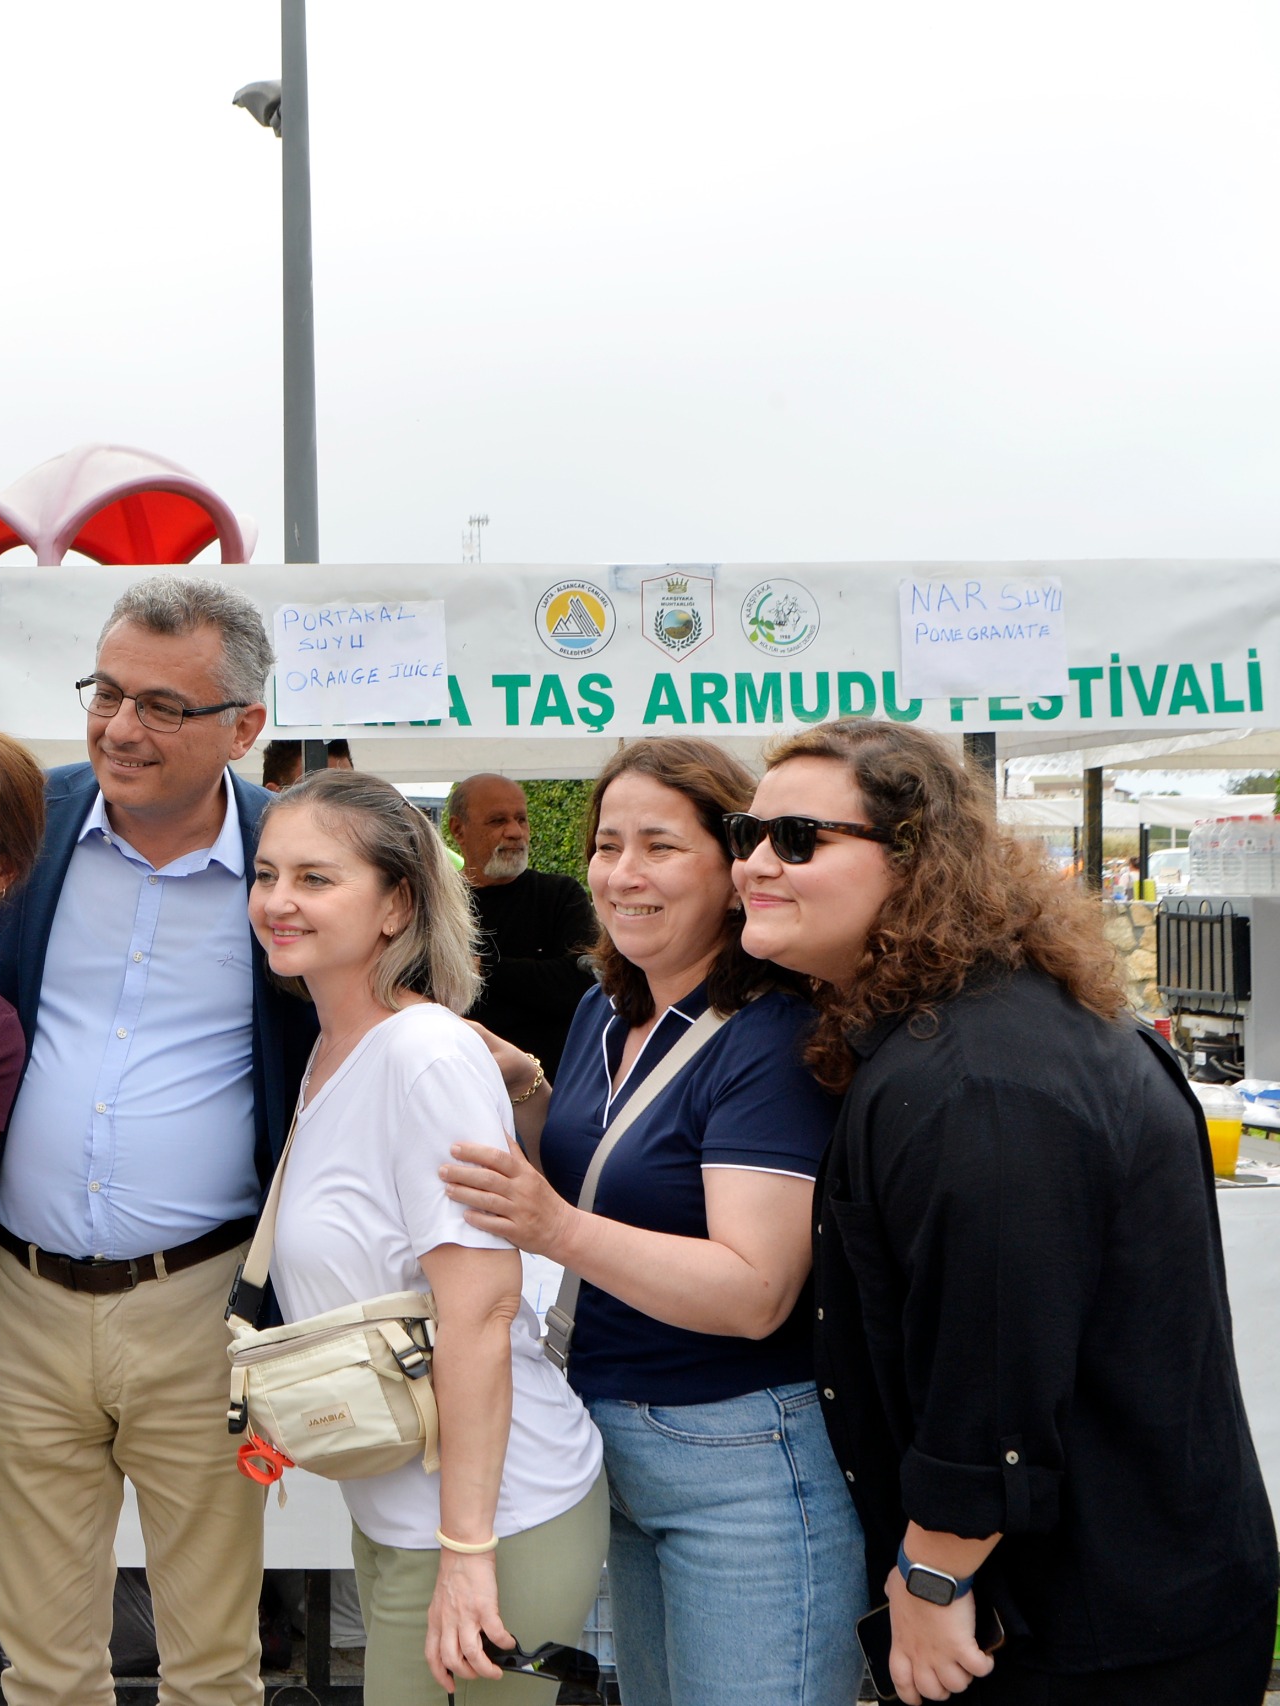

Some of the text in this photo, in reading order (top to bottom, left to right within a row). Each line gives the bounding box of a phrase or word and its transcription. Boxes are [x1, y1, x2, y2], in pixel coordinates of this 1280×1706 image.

[912, 582, 1062, 615] NAR SUYU
[283, 606, 416, 632] PORTAKAL
[298, 634, 365, 652] SUYU
[559, 646, 594, 656] BELEDİYESİ
[286, 668, 381, 692] ORANGE
[492, 672, 615, 733] TAŞ
[642, 671, 923, 724] ARMUDU
